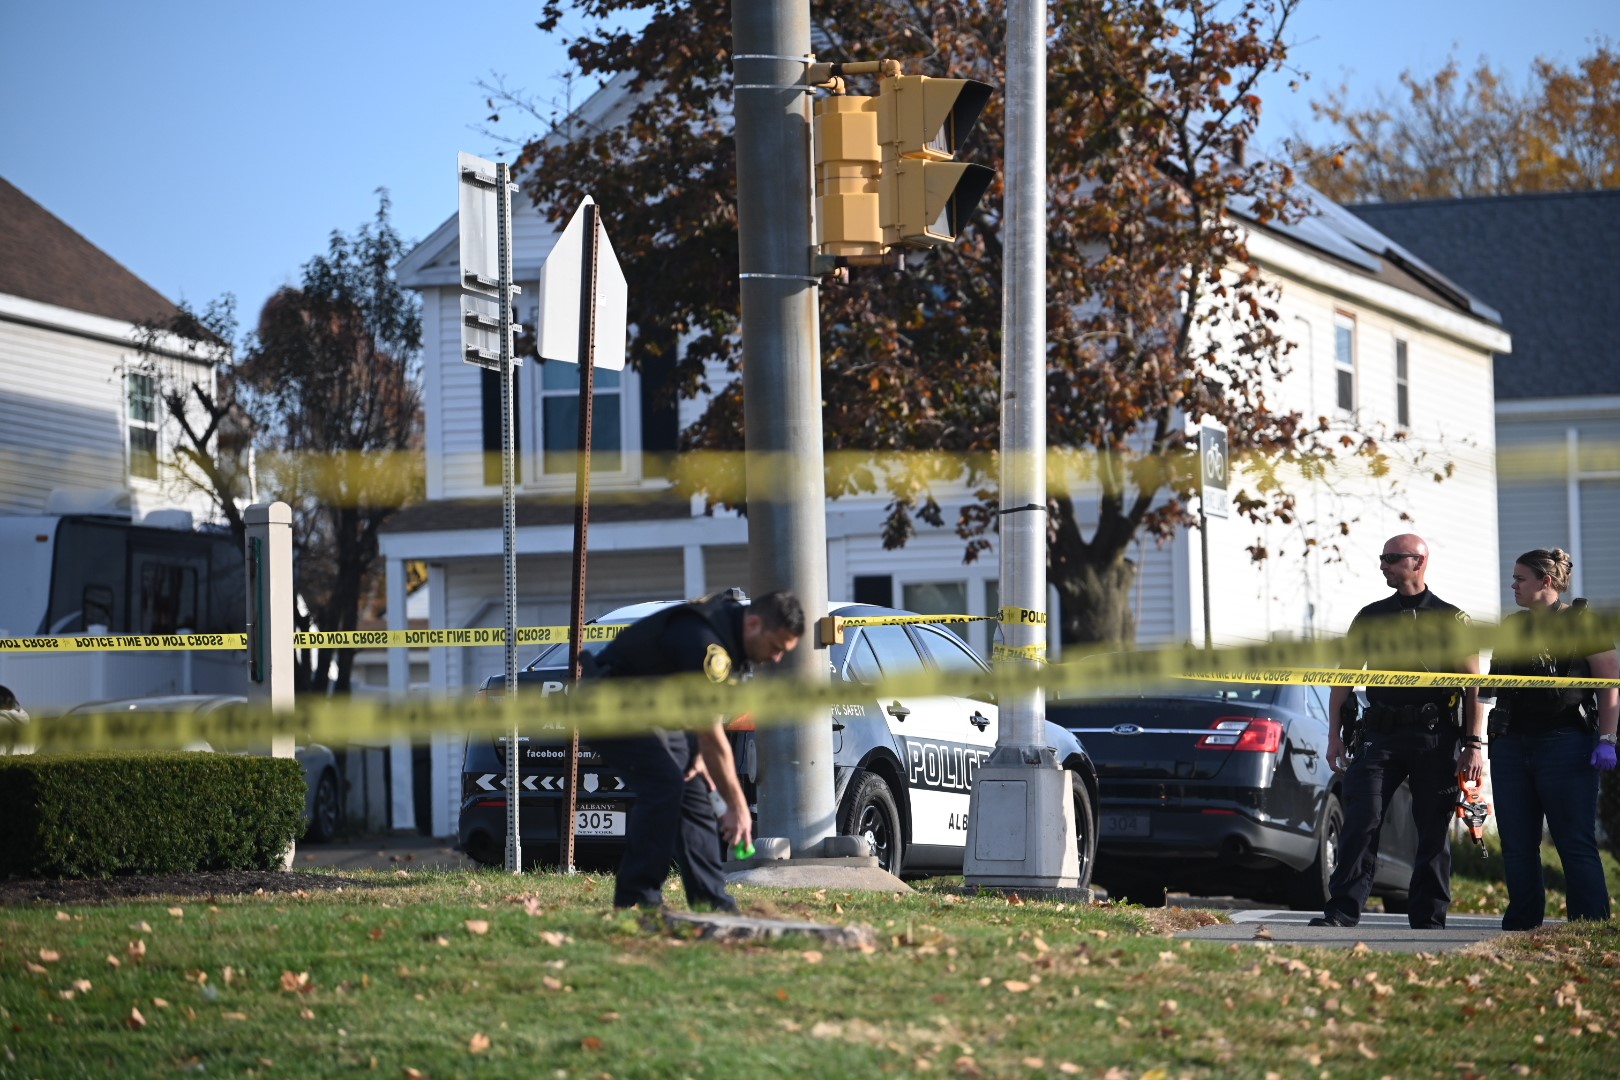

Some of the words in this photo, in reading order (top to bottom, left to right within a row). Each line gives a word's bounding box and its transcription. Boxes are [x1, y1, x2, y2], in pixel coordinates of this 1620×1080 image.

[843, 704, 866, 717] SAFETY
[578, 812, 613, 829] 305
[1108, 816, 1137, 831] 304
